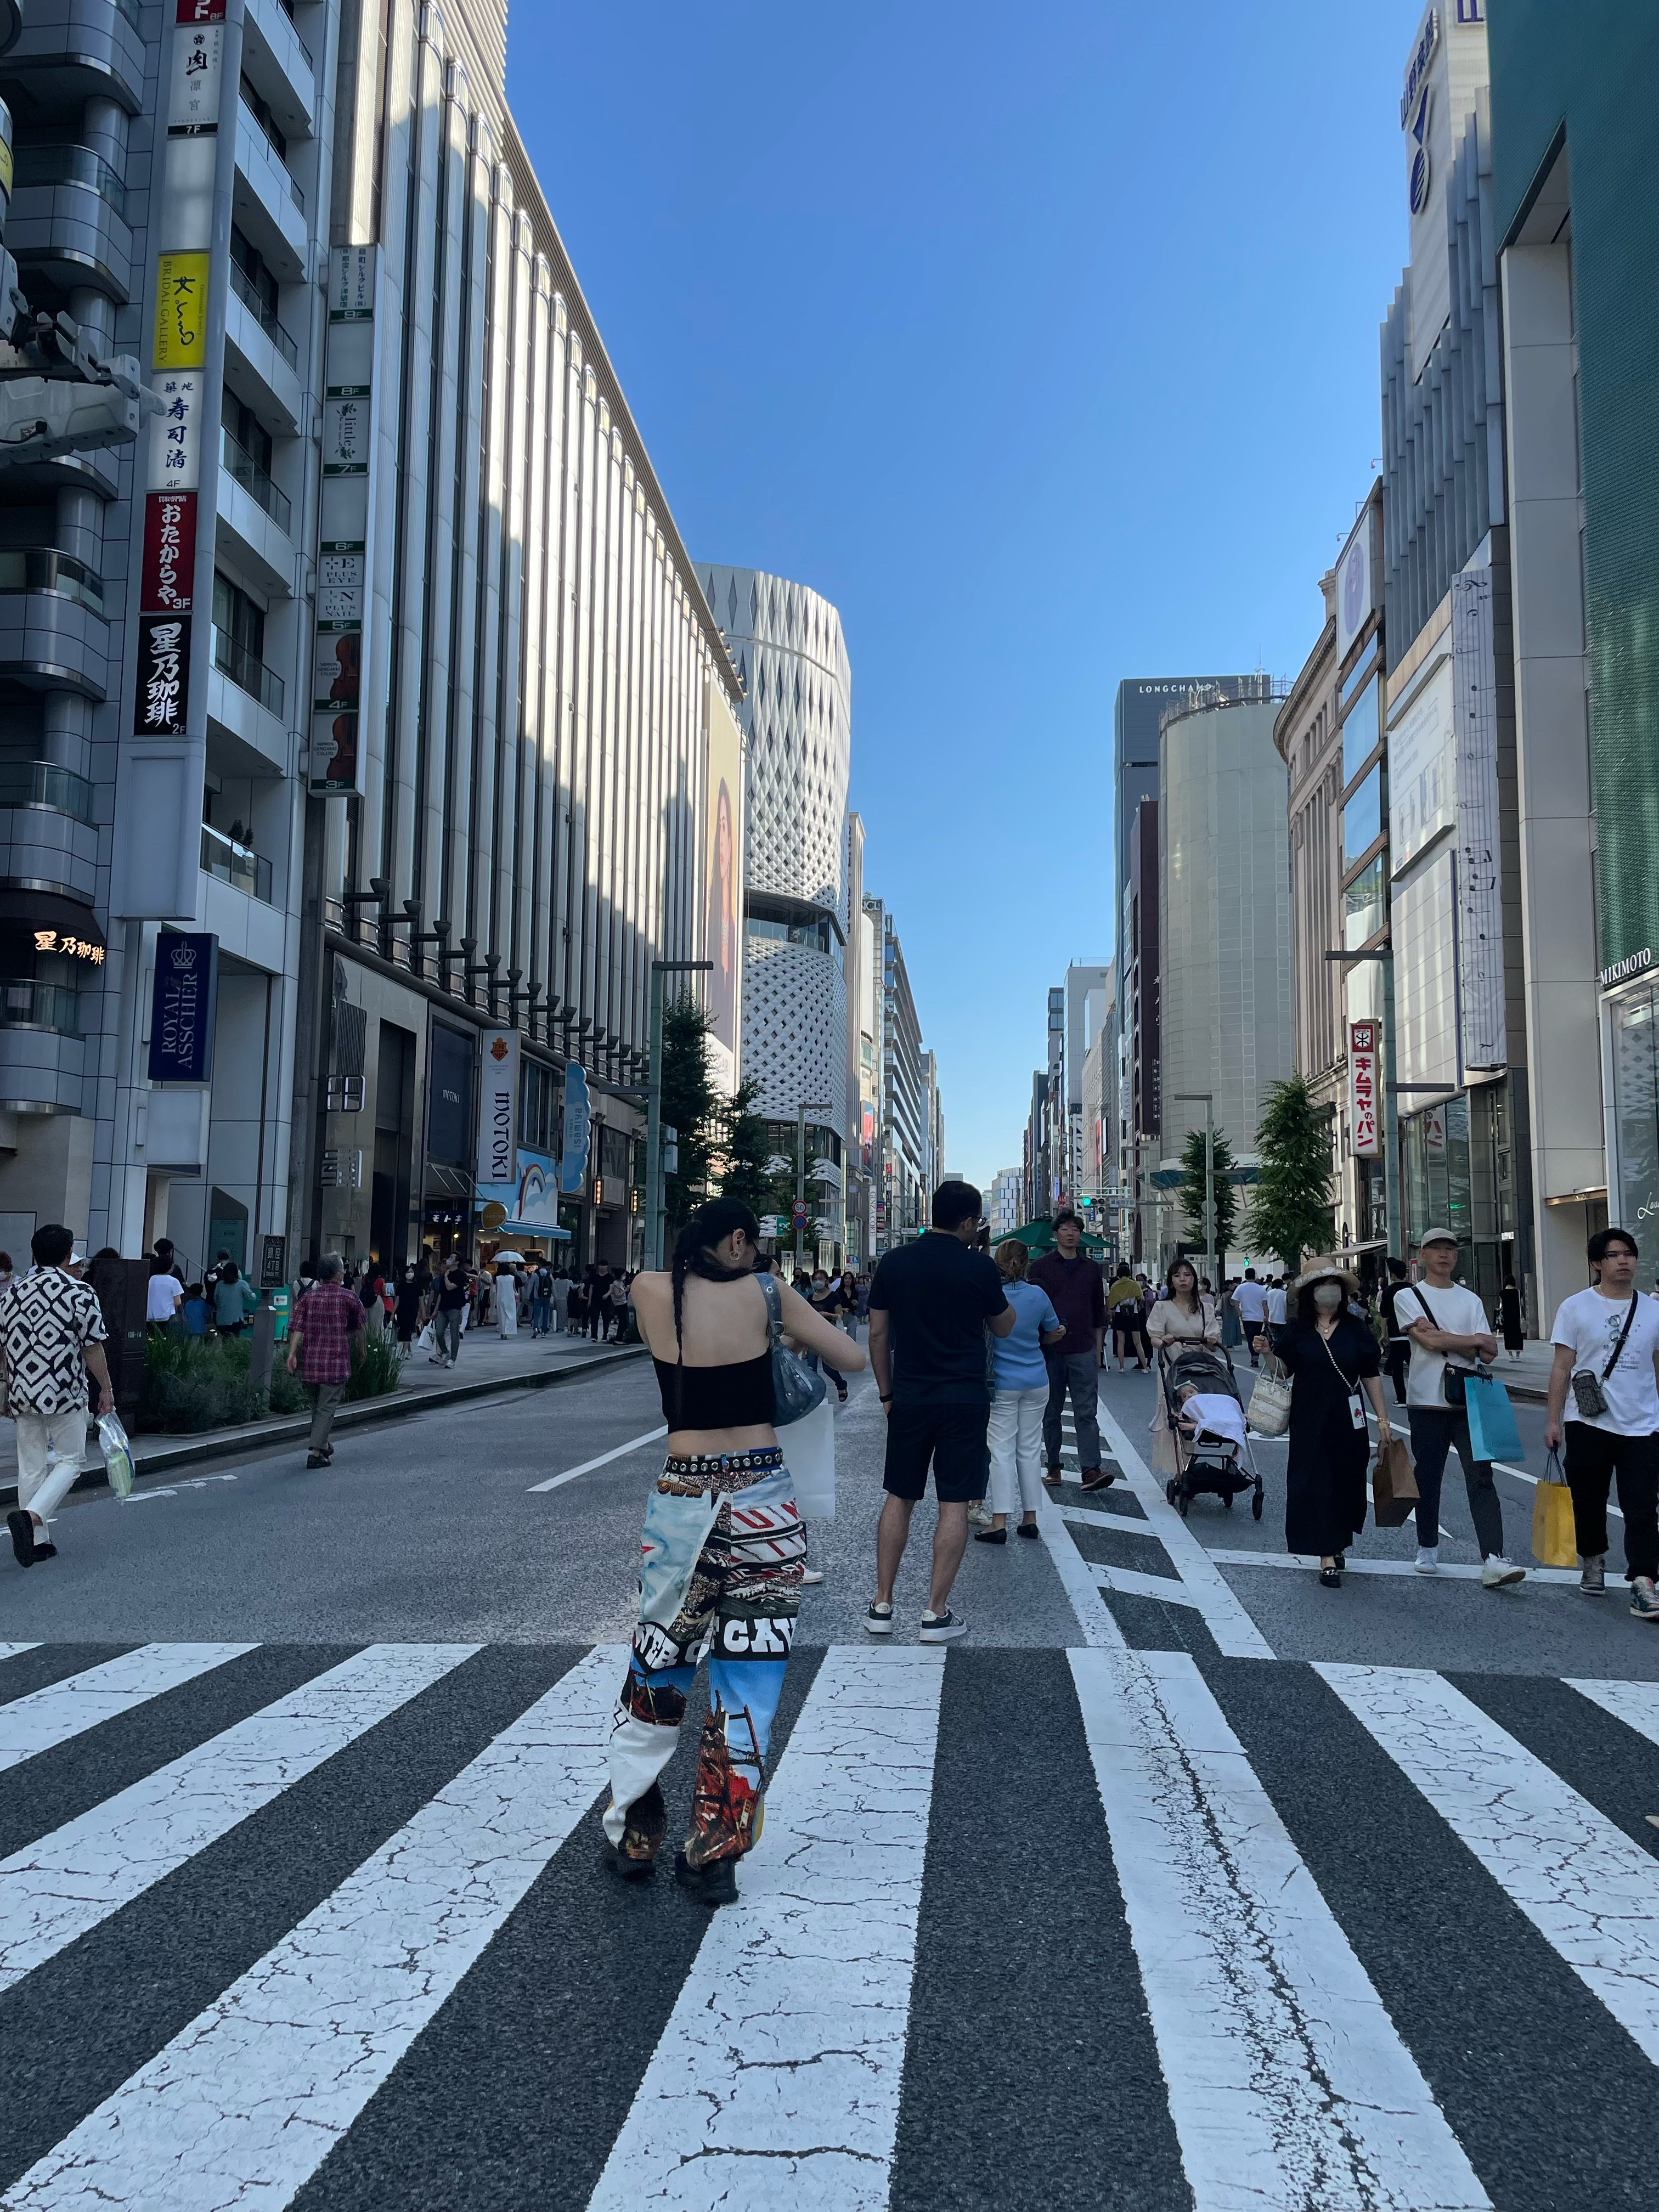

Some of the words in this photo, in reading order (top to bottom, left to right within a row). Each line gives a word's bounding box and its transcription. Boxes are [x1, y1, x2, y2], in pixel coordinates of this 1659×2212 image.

[210, 12, 224, 20] 8F
[187, 126, 201, 134] 7F
[162, 261, 172, 306] BRIDAL
[344, 311, 363, 319] 9F
[158, 308, 169, 363] GALLERY
[341, 387, 359, 396] 8F
[166, 397, 189, 469] 寿司清
[343, 417, 357, 447] little
[338, 465, 356, 473] 7F
[157, 503, 181, 605] おたからや
[335, 542, 354, 551] 6F
[172, 598, 191, 609] 3F
[332, 621, 351, 630] 5F
[144, 622, 182, 727] 星乃珈琲
[329, 700, 347, 708] 4F
[172, 723, 186, 734] 2F
[325, 780, 345, 788] 3F
[34, 931, 105, 965] 星乃珈琲
[1600, 948, 1650, 986] MIKIMOTO
[162, 986, 180, 1054] ROYAL
[178, 973, 198, 1069] ASSCHER
[1356, 1057, 1375, 1147] キムラヤのパン
[492, 1091, 510, 1178] MOTOKI
[432, 1215, 462, 1223] モトキ
